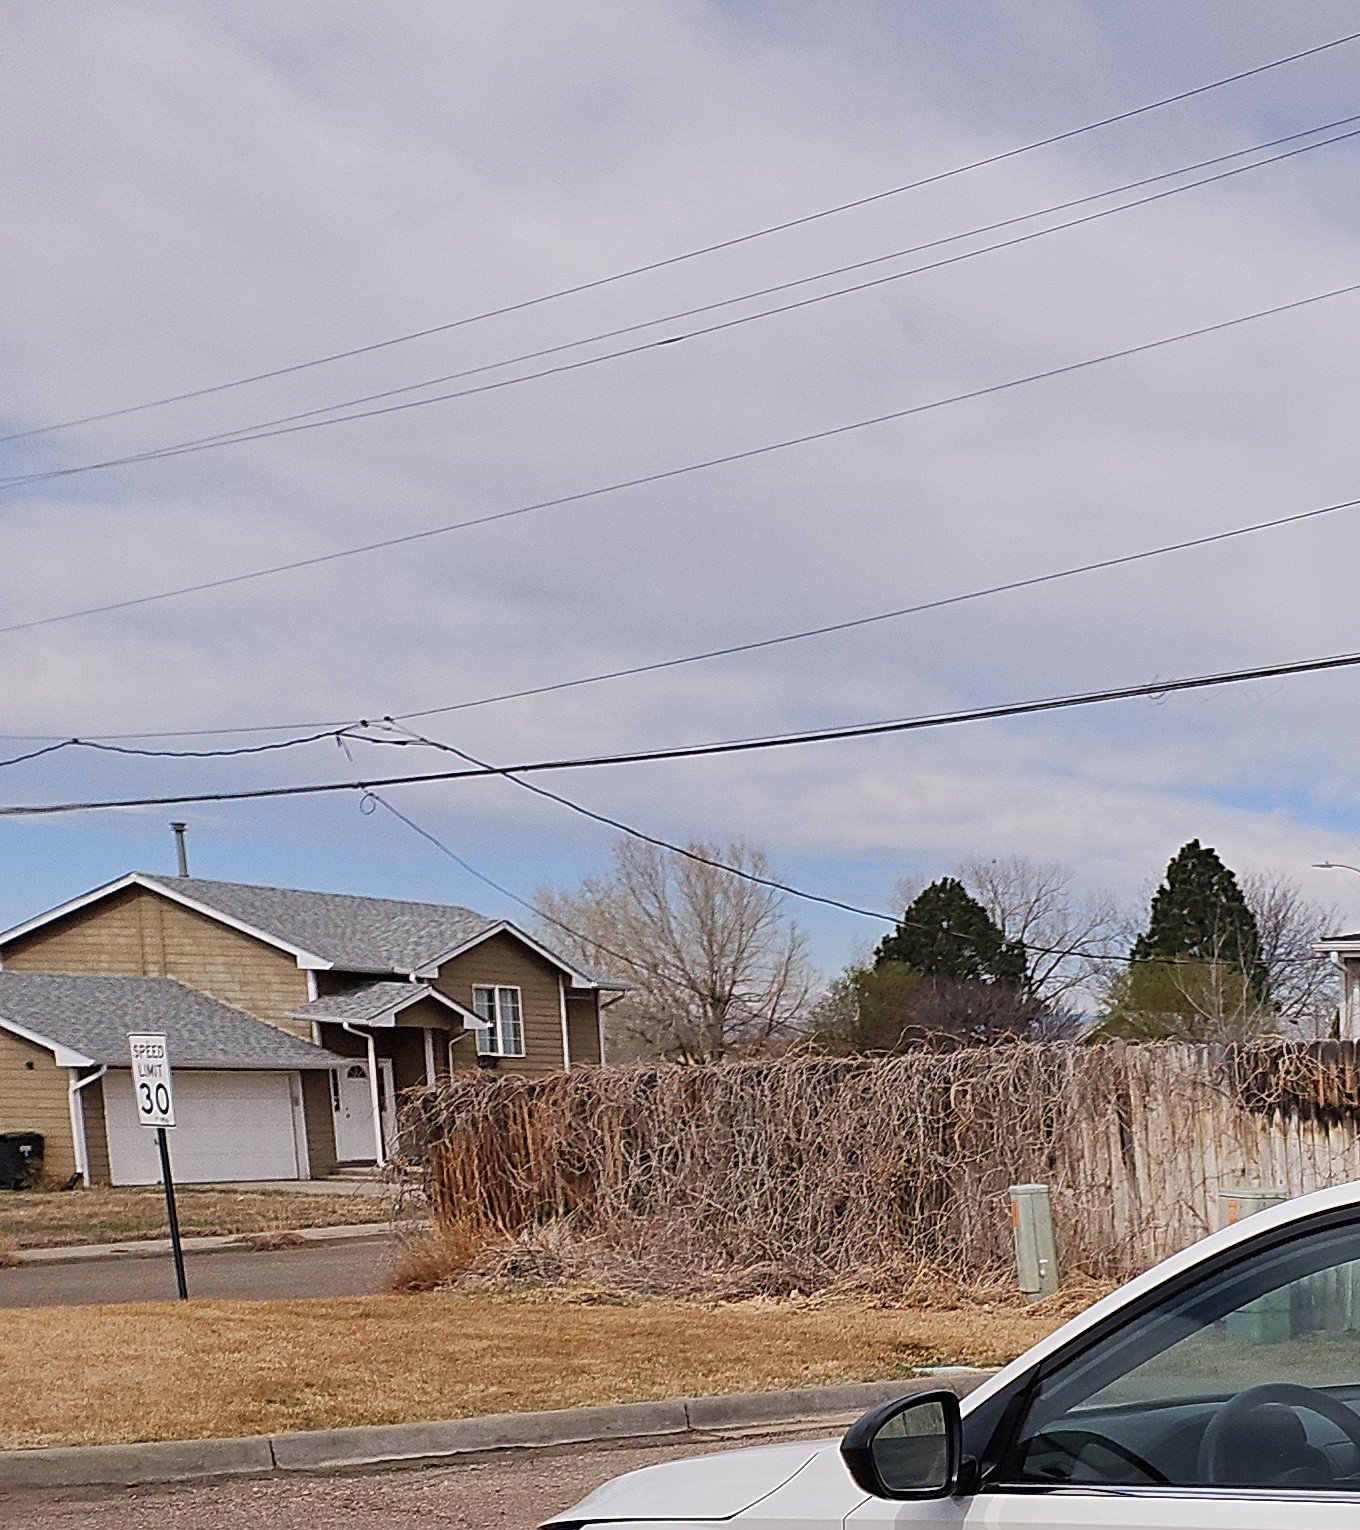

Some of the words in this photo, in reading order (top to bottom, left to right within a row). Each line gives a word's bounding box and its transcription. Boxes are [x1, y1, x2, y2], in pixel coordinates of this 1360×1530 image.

[133, 1044, 164, 1059] SPEED
[138, 1063, 162, 1077] LIMIT
[140, 1082, 169, 1115] 30
